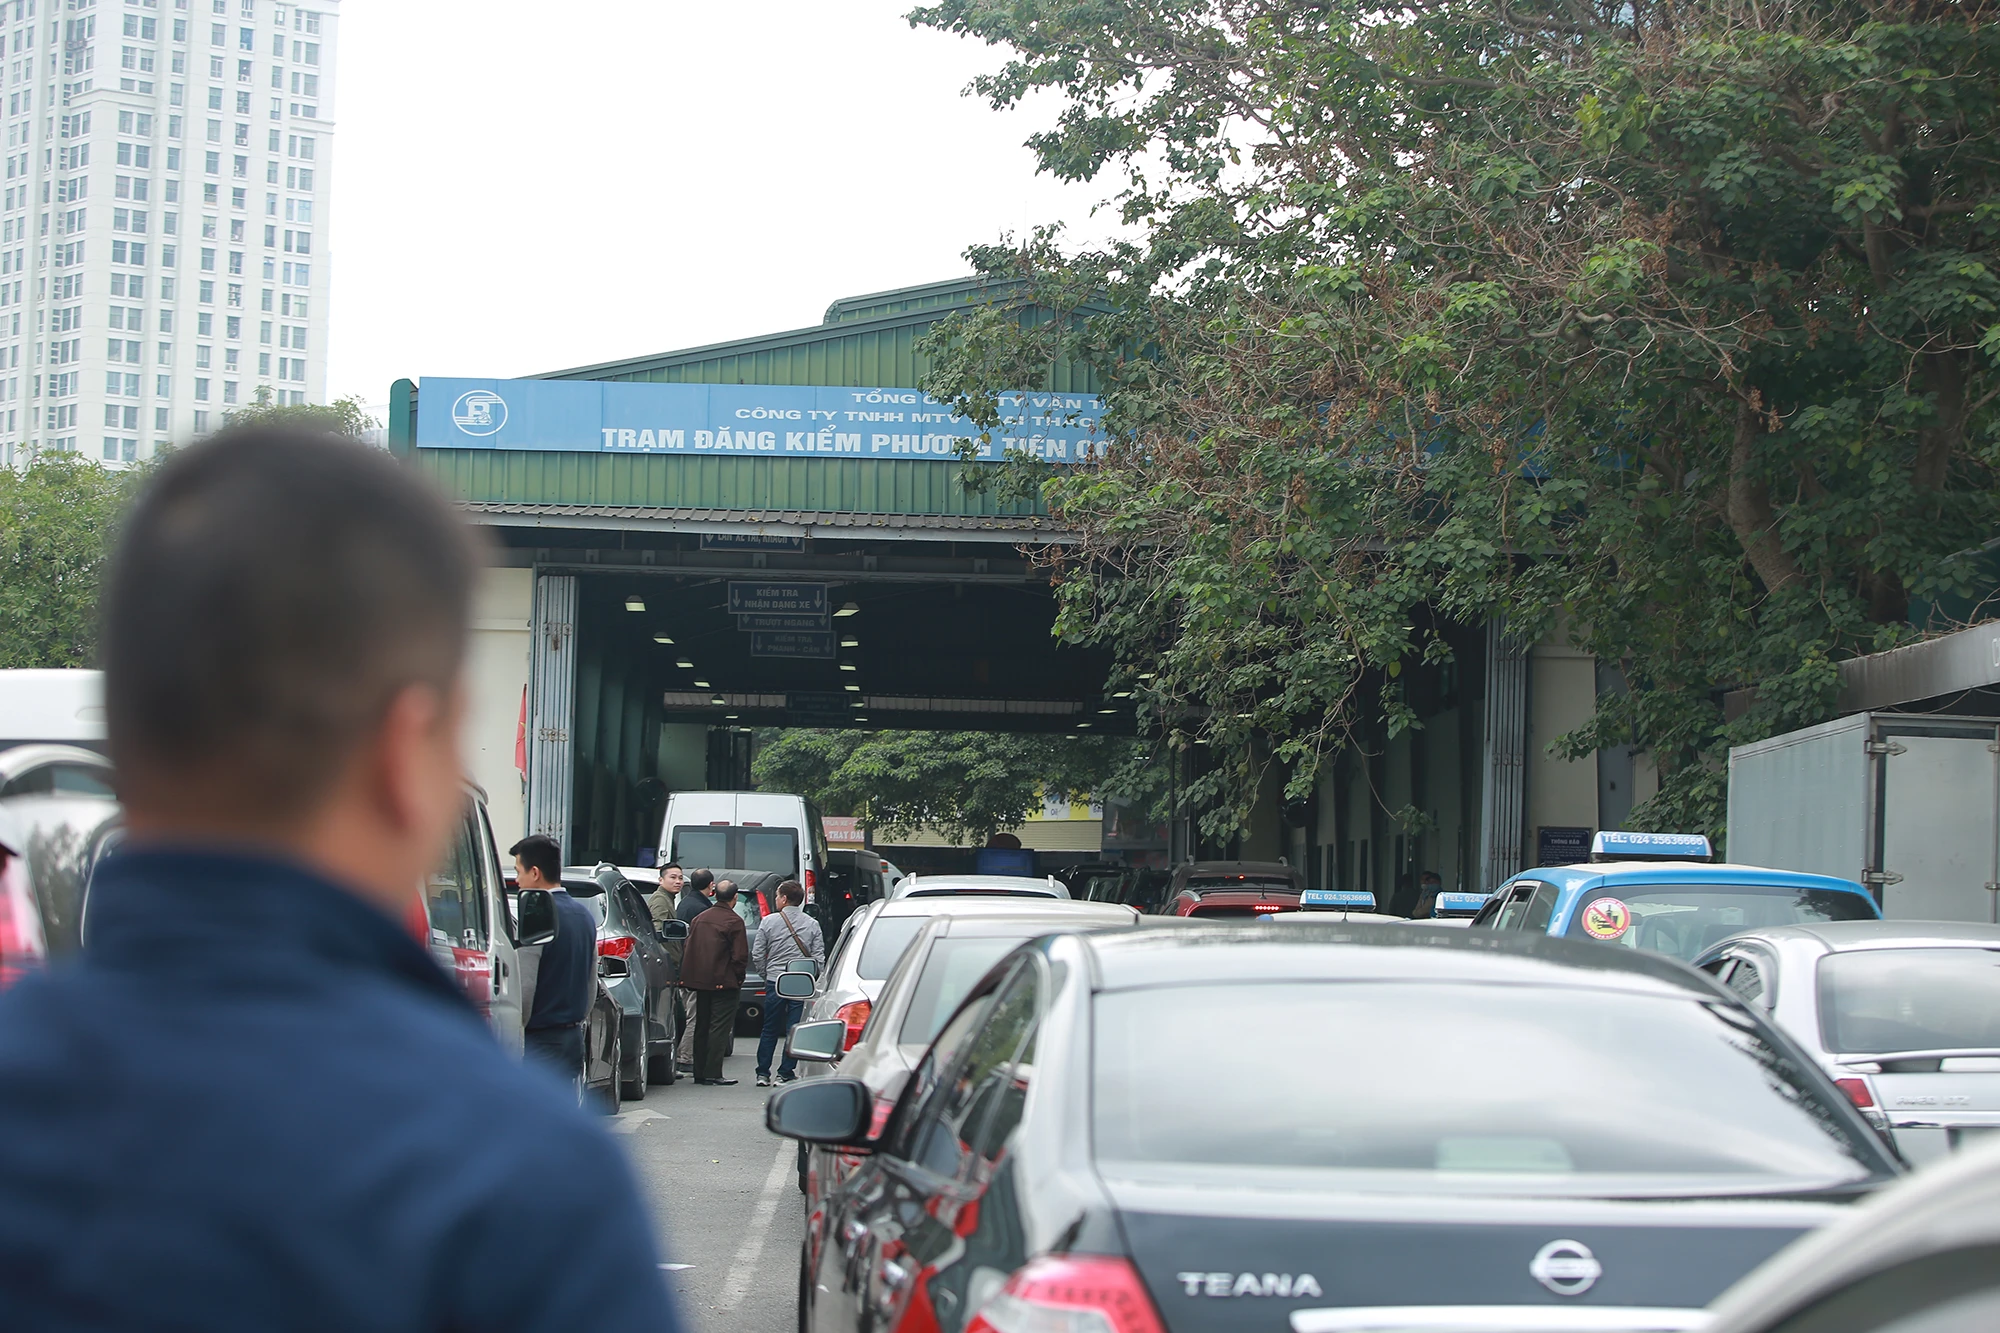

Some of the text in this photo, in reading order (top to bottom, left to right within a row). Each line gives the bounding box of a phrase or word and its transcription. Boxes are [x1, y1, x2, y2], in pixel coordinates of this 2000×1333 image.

[852, 388, 916, 405] TỔNG
[998, 396, 1024, 408] TY
[1032, 396, 1081, 411] VẬN
[735, 406, 801, 420] CÔNG
[807, 410, 838, 421] TY
[844, 411, 904, 422] TNHH
[911, 413, 963, 424] MTV
[601, 428, 685, 452] TRẠM
[694, 426, 776, 451] ĐĂNG
[785, 424, 861, 453] KIỂM
[782, 589, 798, 597] TRA
[799, 601, 811, 609] XE
[1629, 834, 1650, 845] 024
[1651, 836, 1704, 846] 35636666
[1177, 1271, 1324, 1298] TEANA
